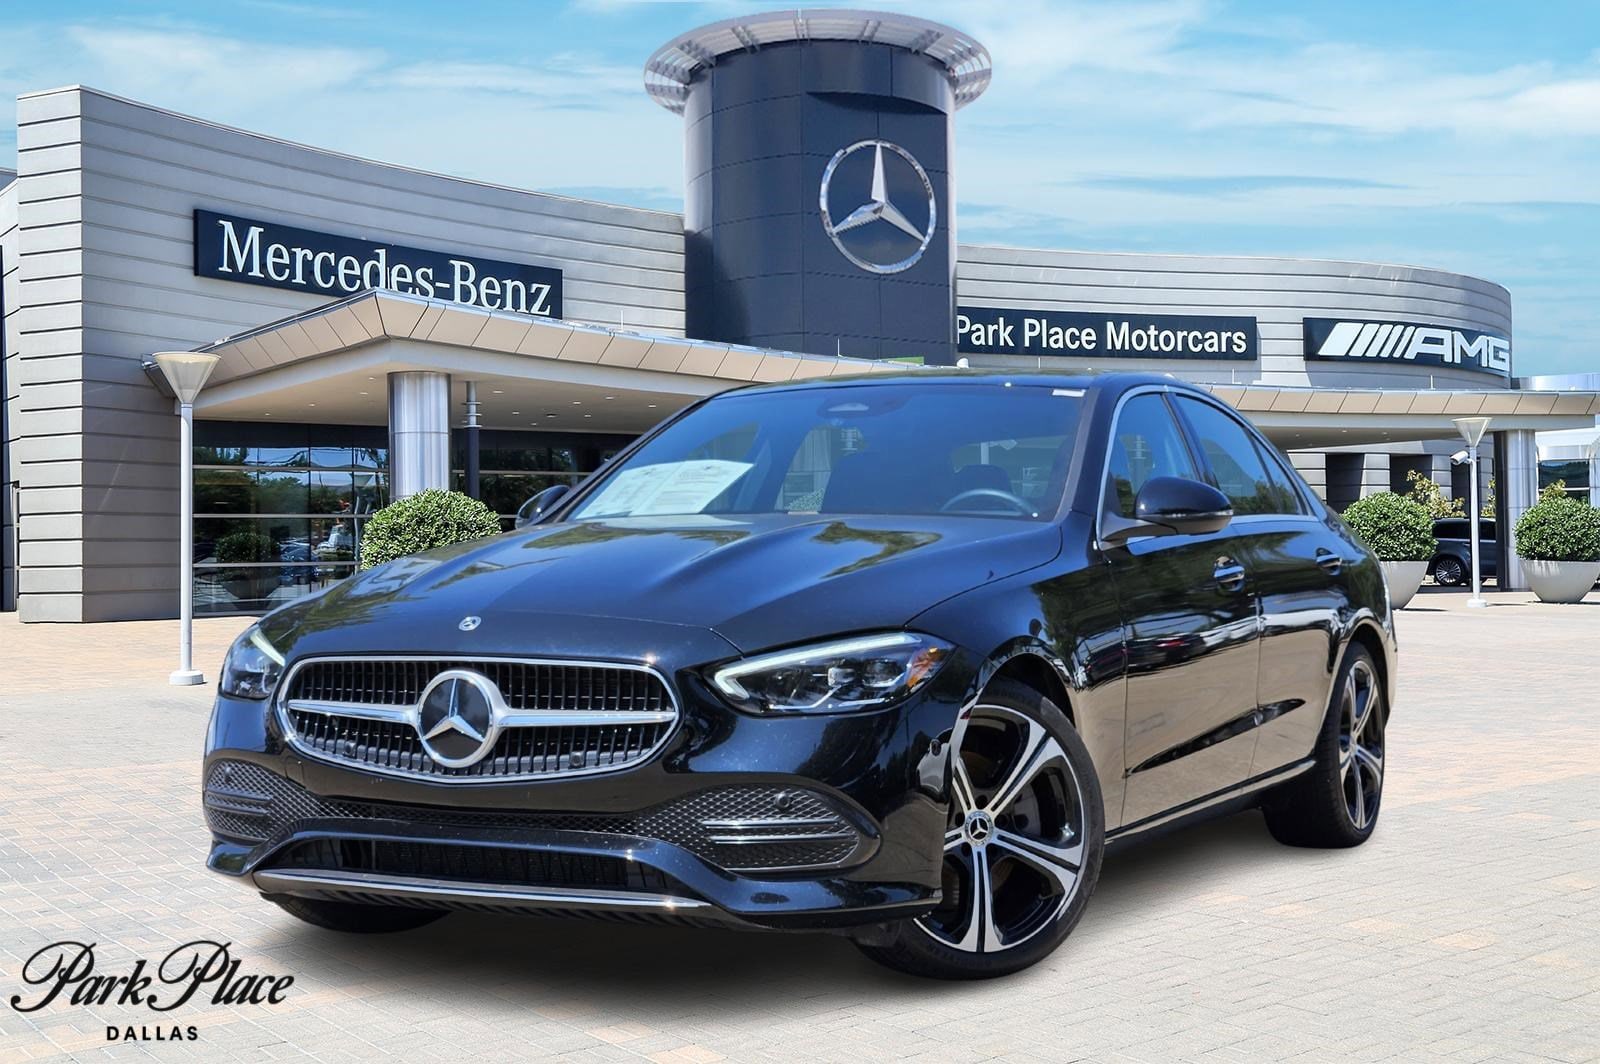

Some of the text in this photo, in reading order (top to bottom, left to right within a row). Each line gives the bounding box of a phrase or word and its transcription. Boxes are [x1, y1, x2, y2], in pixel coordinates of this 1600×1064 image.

[217, 219, 552, 316] Mercedes-Benz
[957, 315, 1247, 353] Park Place Motorcars
[1404, 326, 1510, 372] AMG
